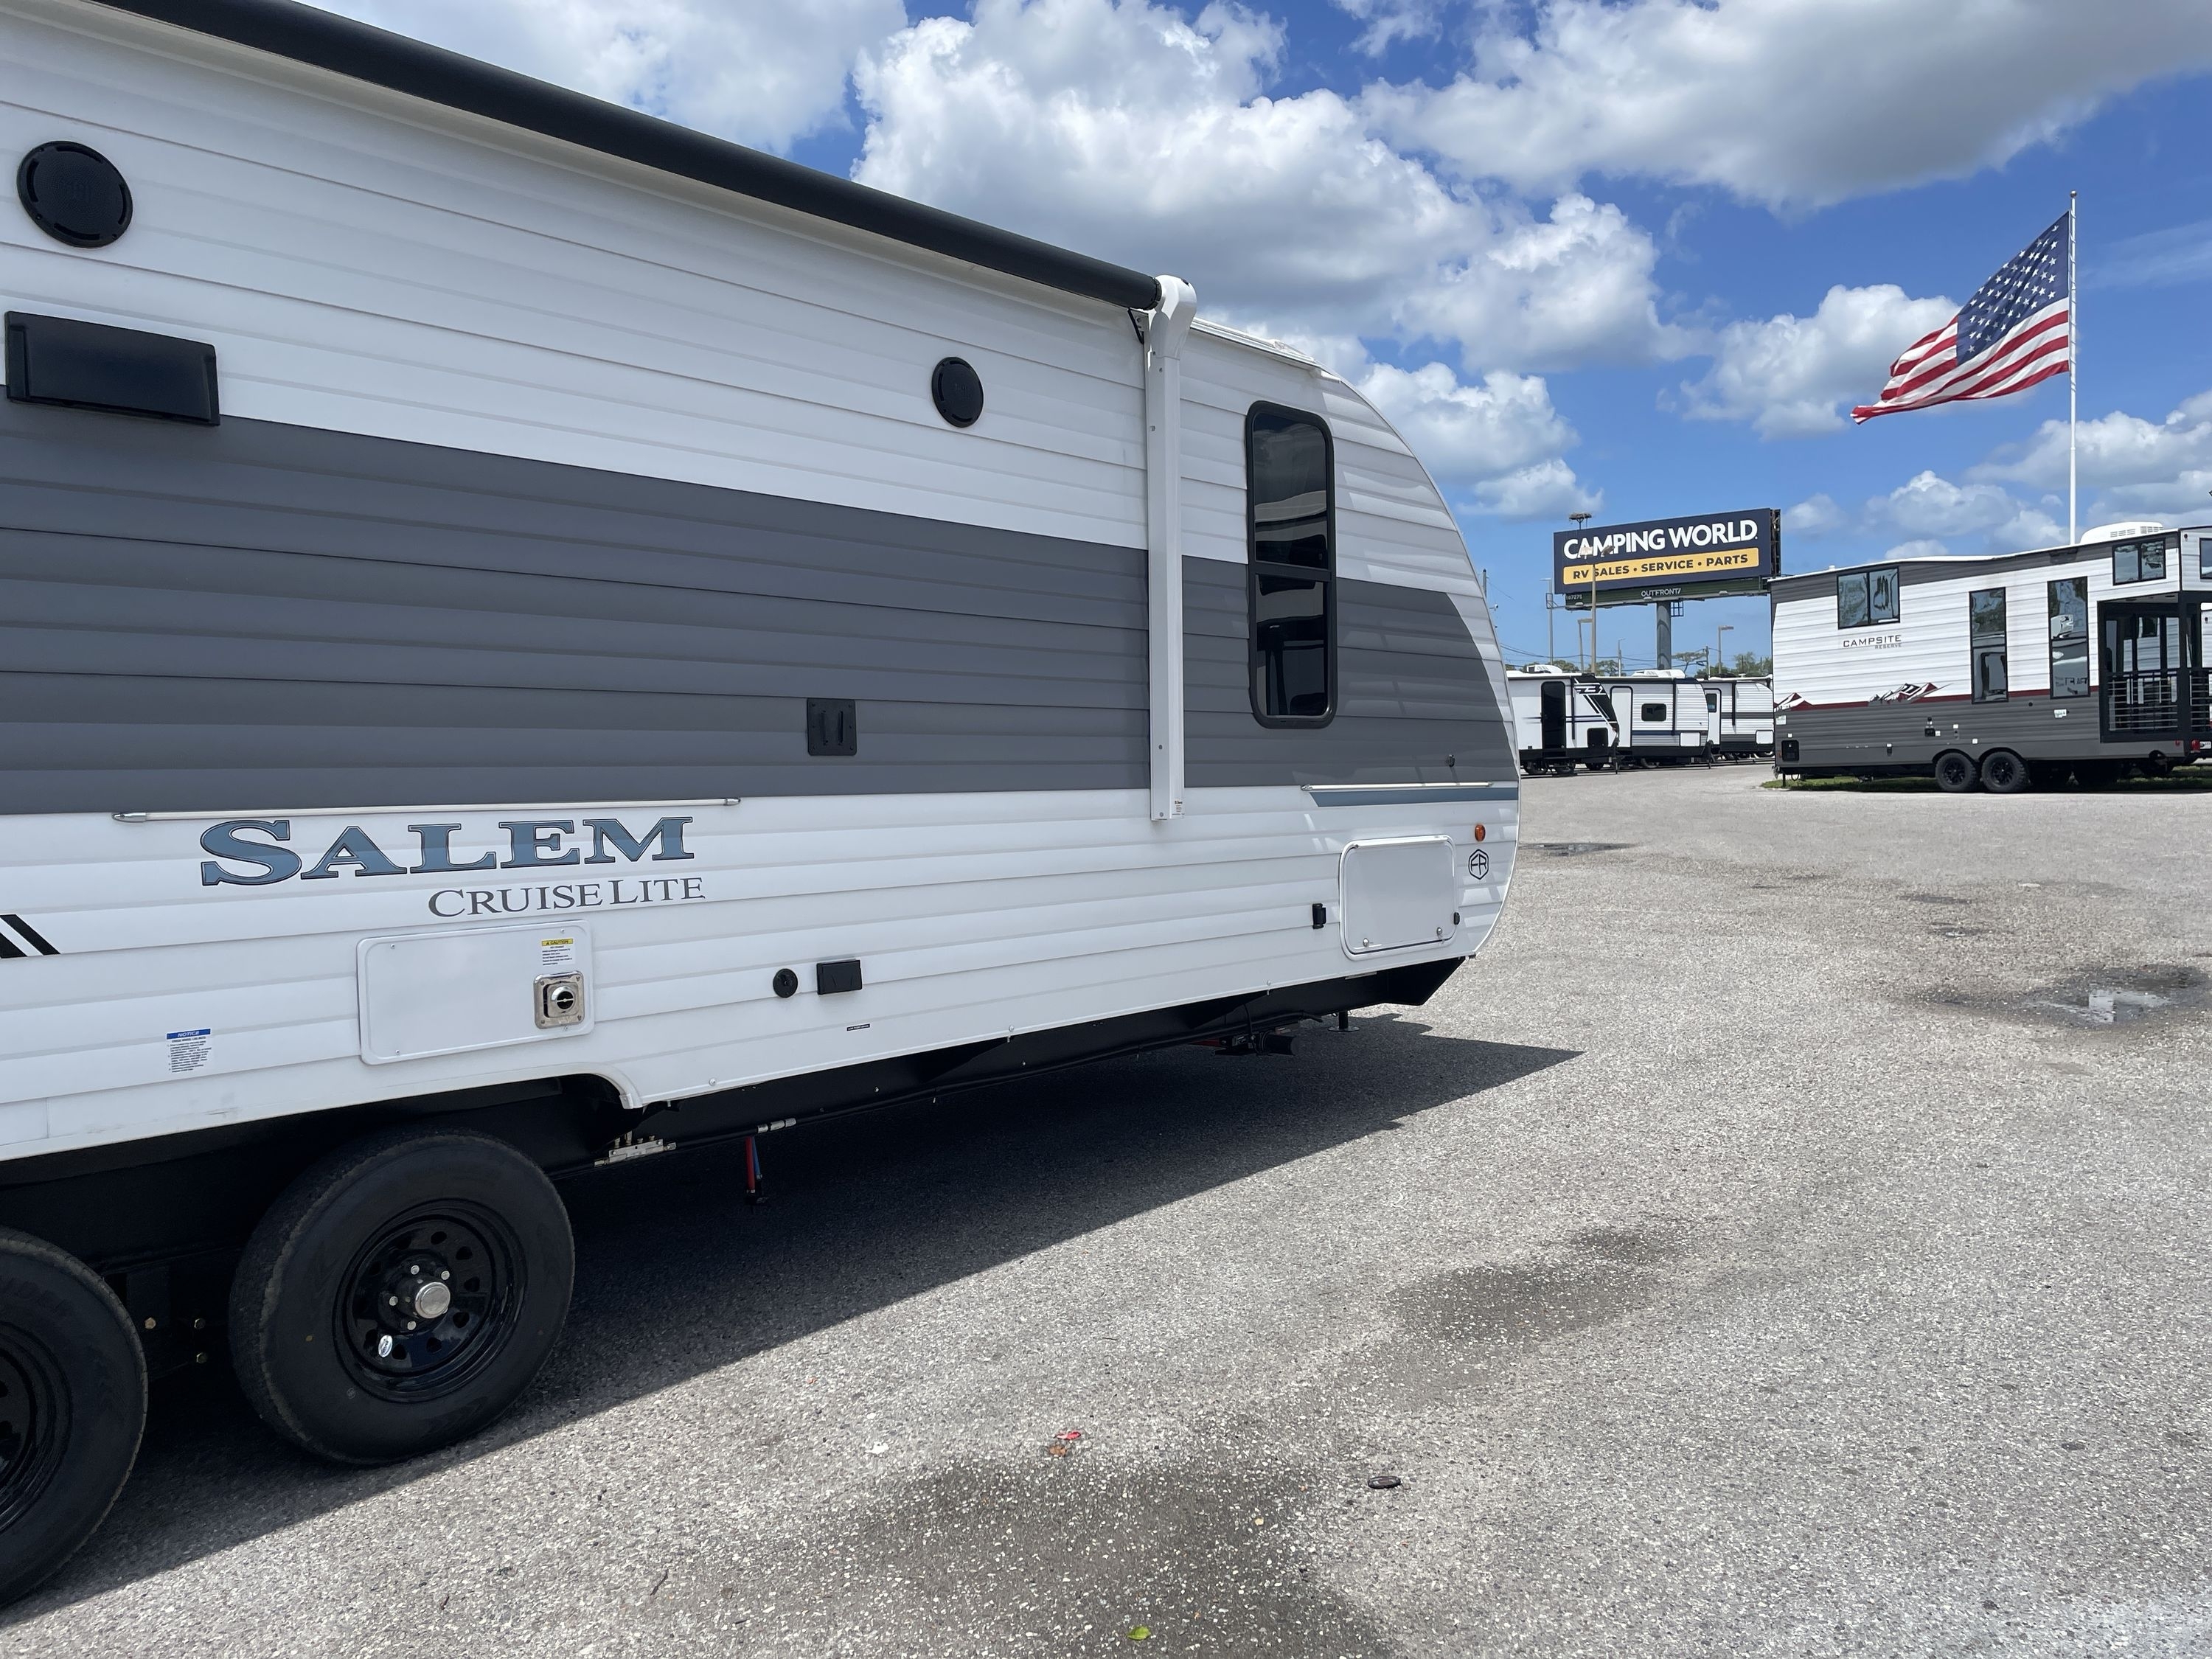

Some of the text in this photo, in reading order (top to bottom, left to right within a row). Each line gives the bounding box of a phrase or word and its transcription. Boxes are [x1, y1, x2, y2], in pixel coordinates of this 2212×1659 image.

[1563, 529, 1666, 560] CAMPING
[1573, 554, 1749, 580] RV SALES SERVICE PARTS
[1843, 634, 1902, 647] CAMPSITE
[201, 816, 695, 886] SALEM
